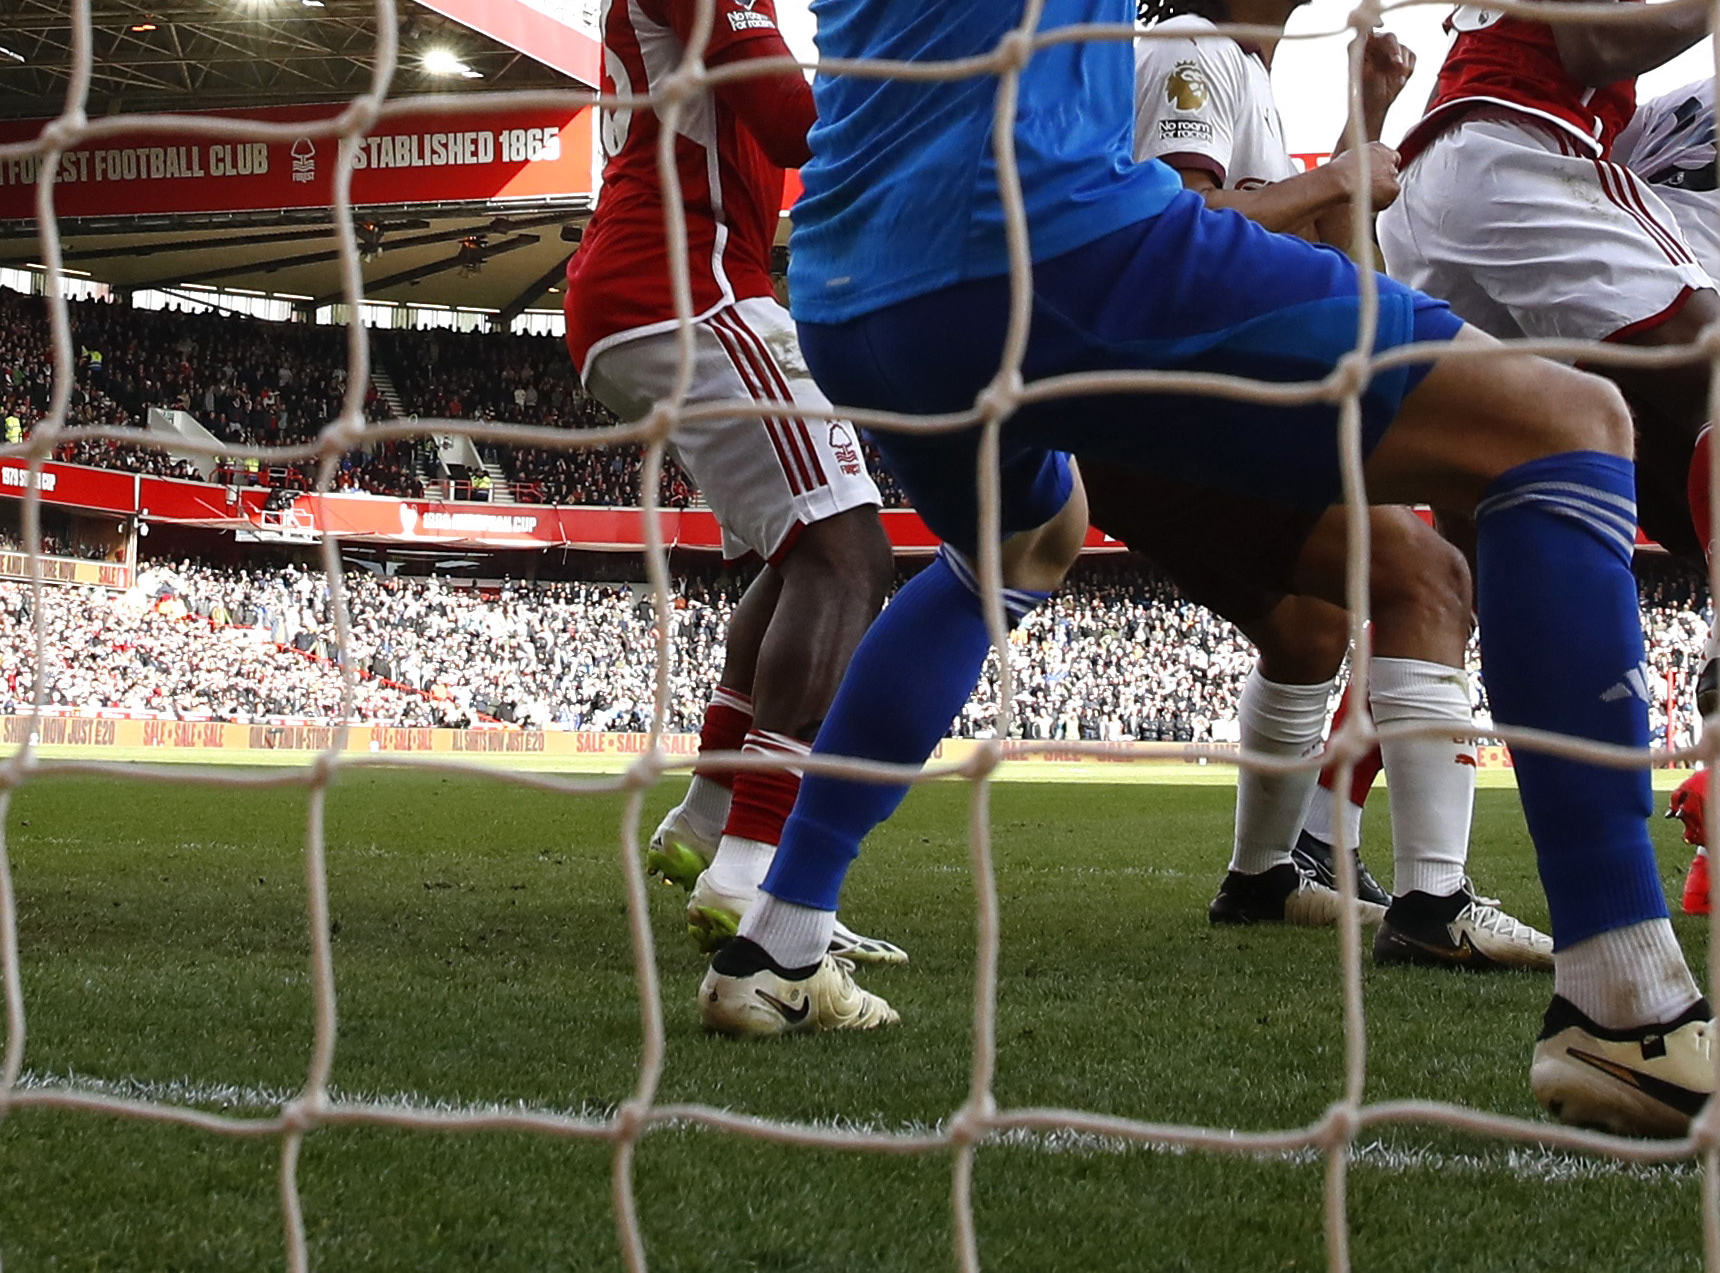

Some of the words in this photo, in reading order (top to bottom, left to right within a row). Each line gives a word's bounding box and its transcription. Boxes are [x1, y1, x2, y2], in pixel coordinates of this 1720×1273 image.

[1159, 120, 1176, 131] No
[1177, 122, 1210, 132] room
[96, 145, 204, 181] FOOTBALL
[209, 142, 268, 176] CLUB
[499, 127, 560, 163] 1865
[513, 515, 537, 533] CUP
[43, 718, 66, 744] NOW
[68, 719, 93, 745] JUST
[174, 722, 196, 747] SALE
[203, 724, 225, 748] SALE
[576, 733, 604, 753] SALE
[616, 733, 646, 754] SALE
[662, 734, 698, 756] SALE
